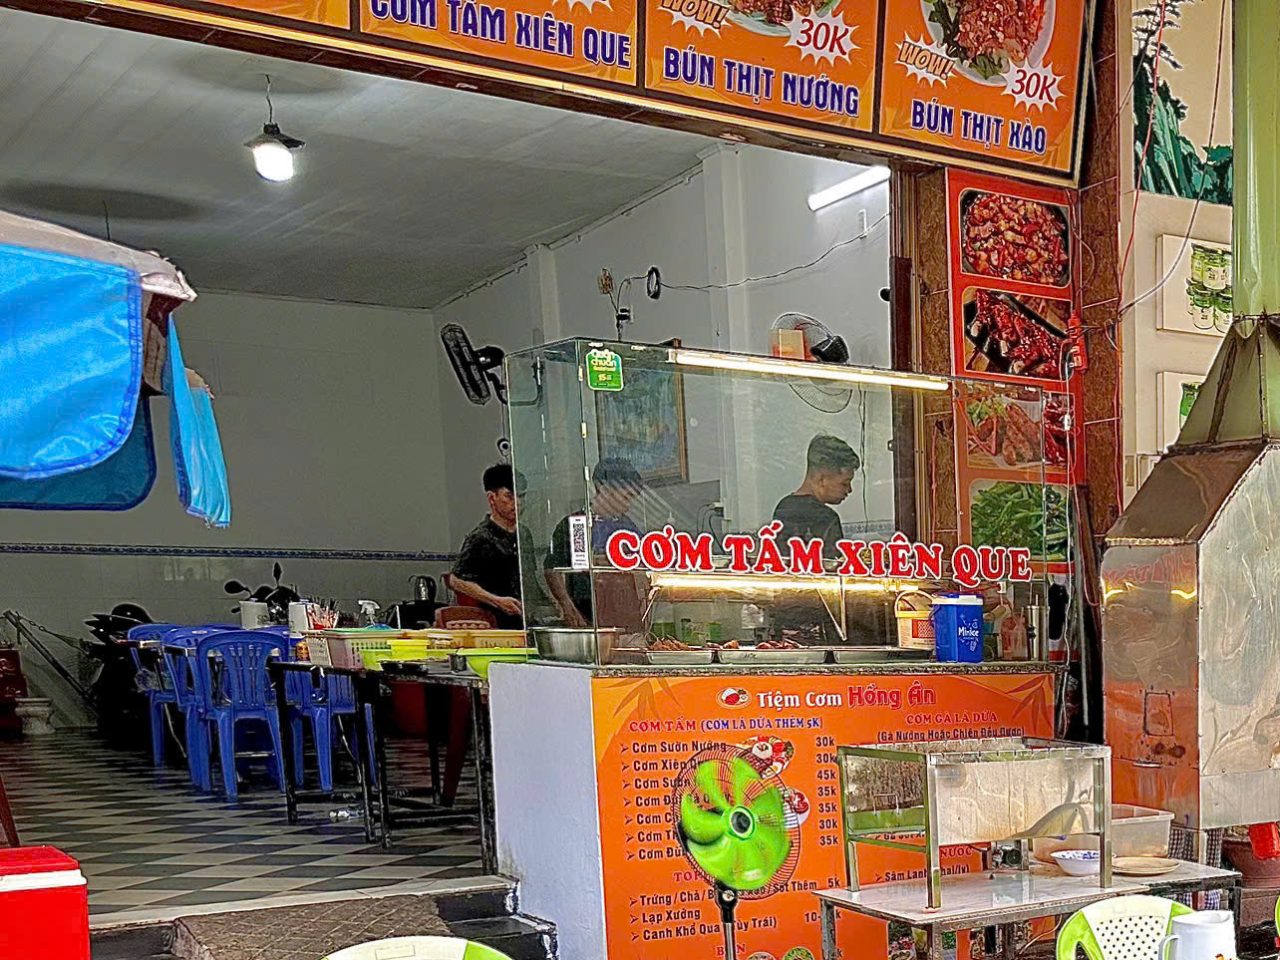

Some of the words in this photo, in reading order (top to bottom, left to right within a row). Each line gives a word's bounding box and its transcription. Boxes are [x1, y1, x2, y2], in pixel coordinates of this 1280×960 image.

[515, 12, 574, 56] XIÊN
[582, 26, 631, 69] QUE
[796, 18, 850, 55] 30K
[898, 41, 954, 80] WOW!
[663, 45, 716, 88] BÚN
[723, 58, 775, 103] THỊT
[782, 71, 859, 117] NƯỚNG
[1011, 69, 1056, 102] 30K
[911, 98, 954, 136] BÚN
[961, 110, 1004, 150] THỊT
[1008, 119, 1047, 155] XÀO
[606, 525, 714, 572] CƠM
[723, 520, 827, 576] TẤM
[836, 533, 943, 580] XIÊN
[951, 544, 1033, 588] QUE
[757, 691, 800, 711] Tiệm
[806, 692, 842, 708] Cơm
[848, 683, 902, 709] Hồng
[907, 681, 937, 707] Ân
[664, 716, 696, 731] TẤM
[632, 742, 657, 753] Cơm
[660, 741, 688, 753] Sườn
[816, 737, 834, 748] 30k
[633, 760, 658, 771] Cơm
[816, 754, 836, 765] 30k
[634, 778, 659, 789] Cơm
[817, 770, 836, 781] 45k
[635, 796, 660, 807] Cơm
[817, 786, 836, 797] 35k
[636, 813, 662, 824] Cơm
[818, 802, 837, 813] 35k
[637, 831, 662, 842] Cơm
[819, 818, 838, 830] 30k
[638, 849, 663, 860] Cơm
[819, 835, 838, 846] 35k
[791, 881, 817, 892] Thêm
[828, 878, 840, 888] 5k
[640, 893, 672, 908] Trứng
[680, 890, 700, 903] Chả
[642, 911, 663, 925] Lạp
[666, 909, 701, 923] Xưởng
[643, 927, 673, 941] Canh
[676, 923, 696, 937] Khổ
[700, 924, 720, 937] Qua
[752, 915, 777, 929] Trái)
[716, 944, 746, 957] BN
